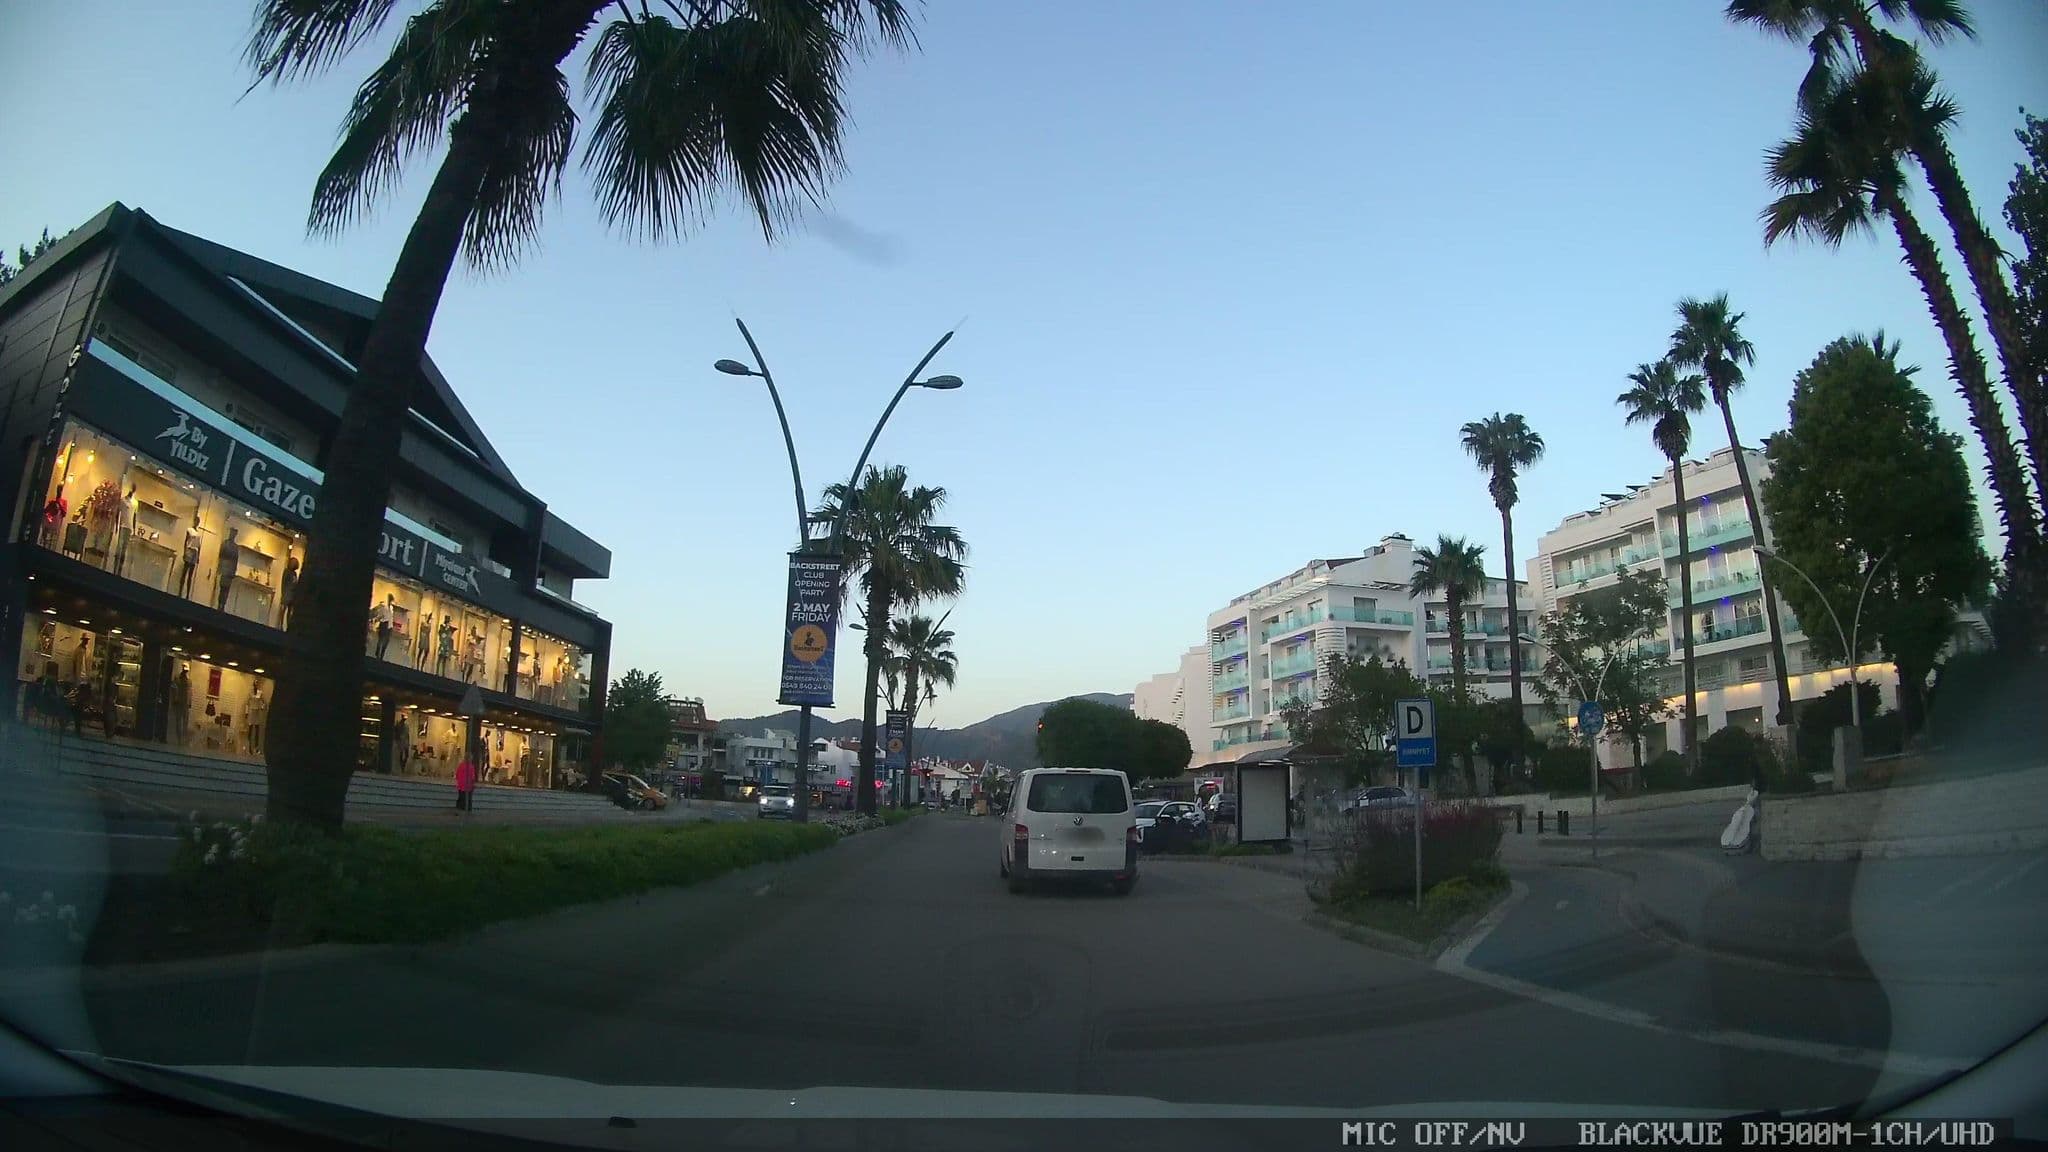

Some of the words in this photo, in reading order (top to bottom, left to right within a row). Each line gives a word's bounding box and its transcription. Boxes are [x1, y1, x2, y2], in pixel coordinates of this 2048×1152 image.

[191, 426, 209, 449] By
[170, 438, 210, 472] YILDIZ
[242, 457, 316, 519] Gaze
[790, 562, 841, 571] BACKSTREET
[804, 571, 825, 579] CLUB
[795, 580, 830, 588] OPENING
[793, 602, 801, 612] 2
[803, 603, 831, 613] MAY
[791, 612, 832, 622] FRIDAY
[1406, 705, 1424, 735] D
